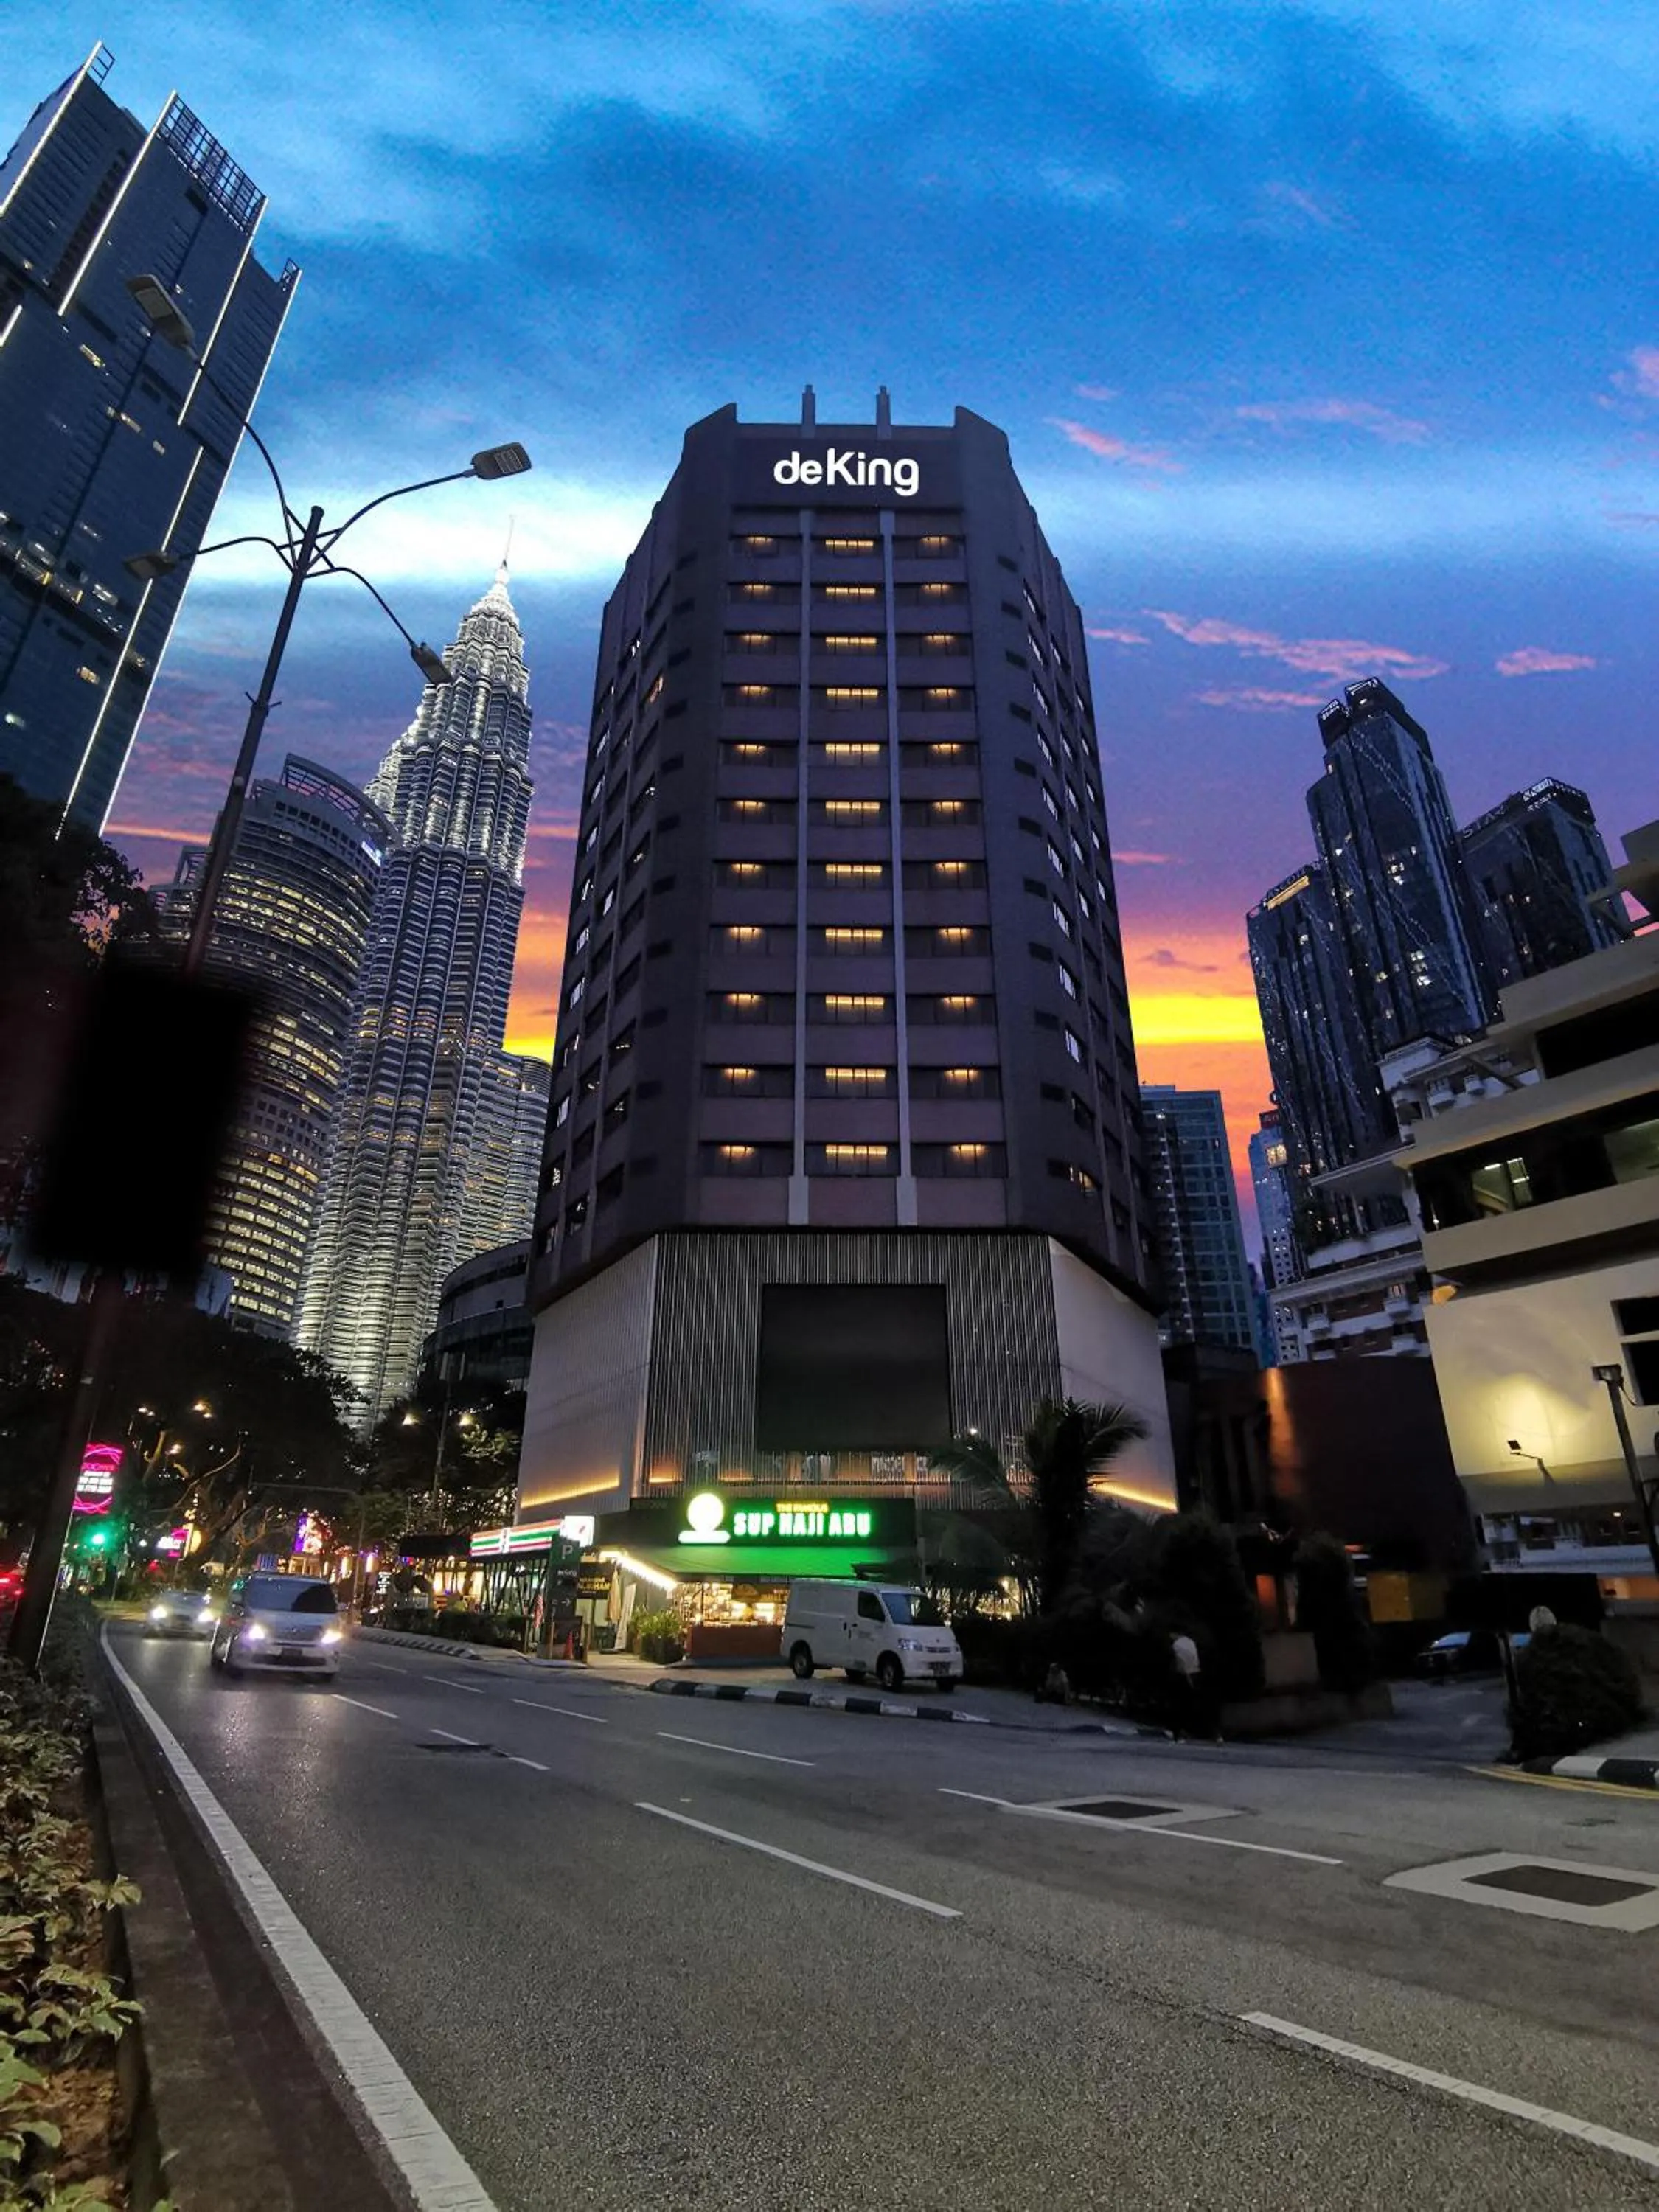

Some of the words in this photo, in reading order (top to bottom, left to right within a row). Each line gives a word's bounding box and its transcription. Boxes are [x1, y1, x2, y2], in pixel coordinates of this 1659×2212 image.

[773, 448, 919, 496] deKing
[734, 1512, 775, 1536] SUP
[779, 1512, 825, 1537] HAJI
[828, 1512, 872, 1537] ABU
